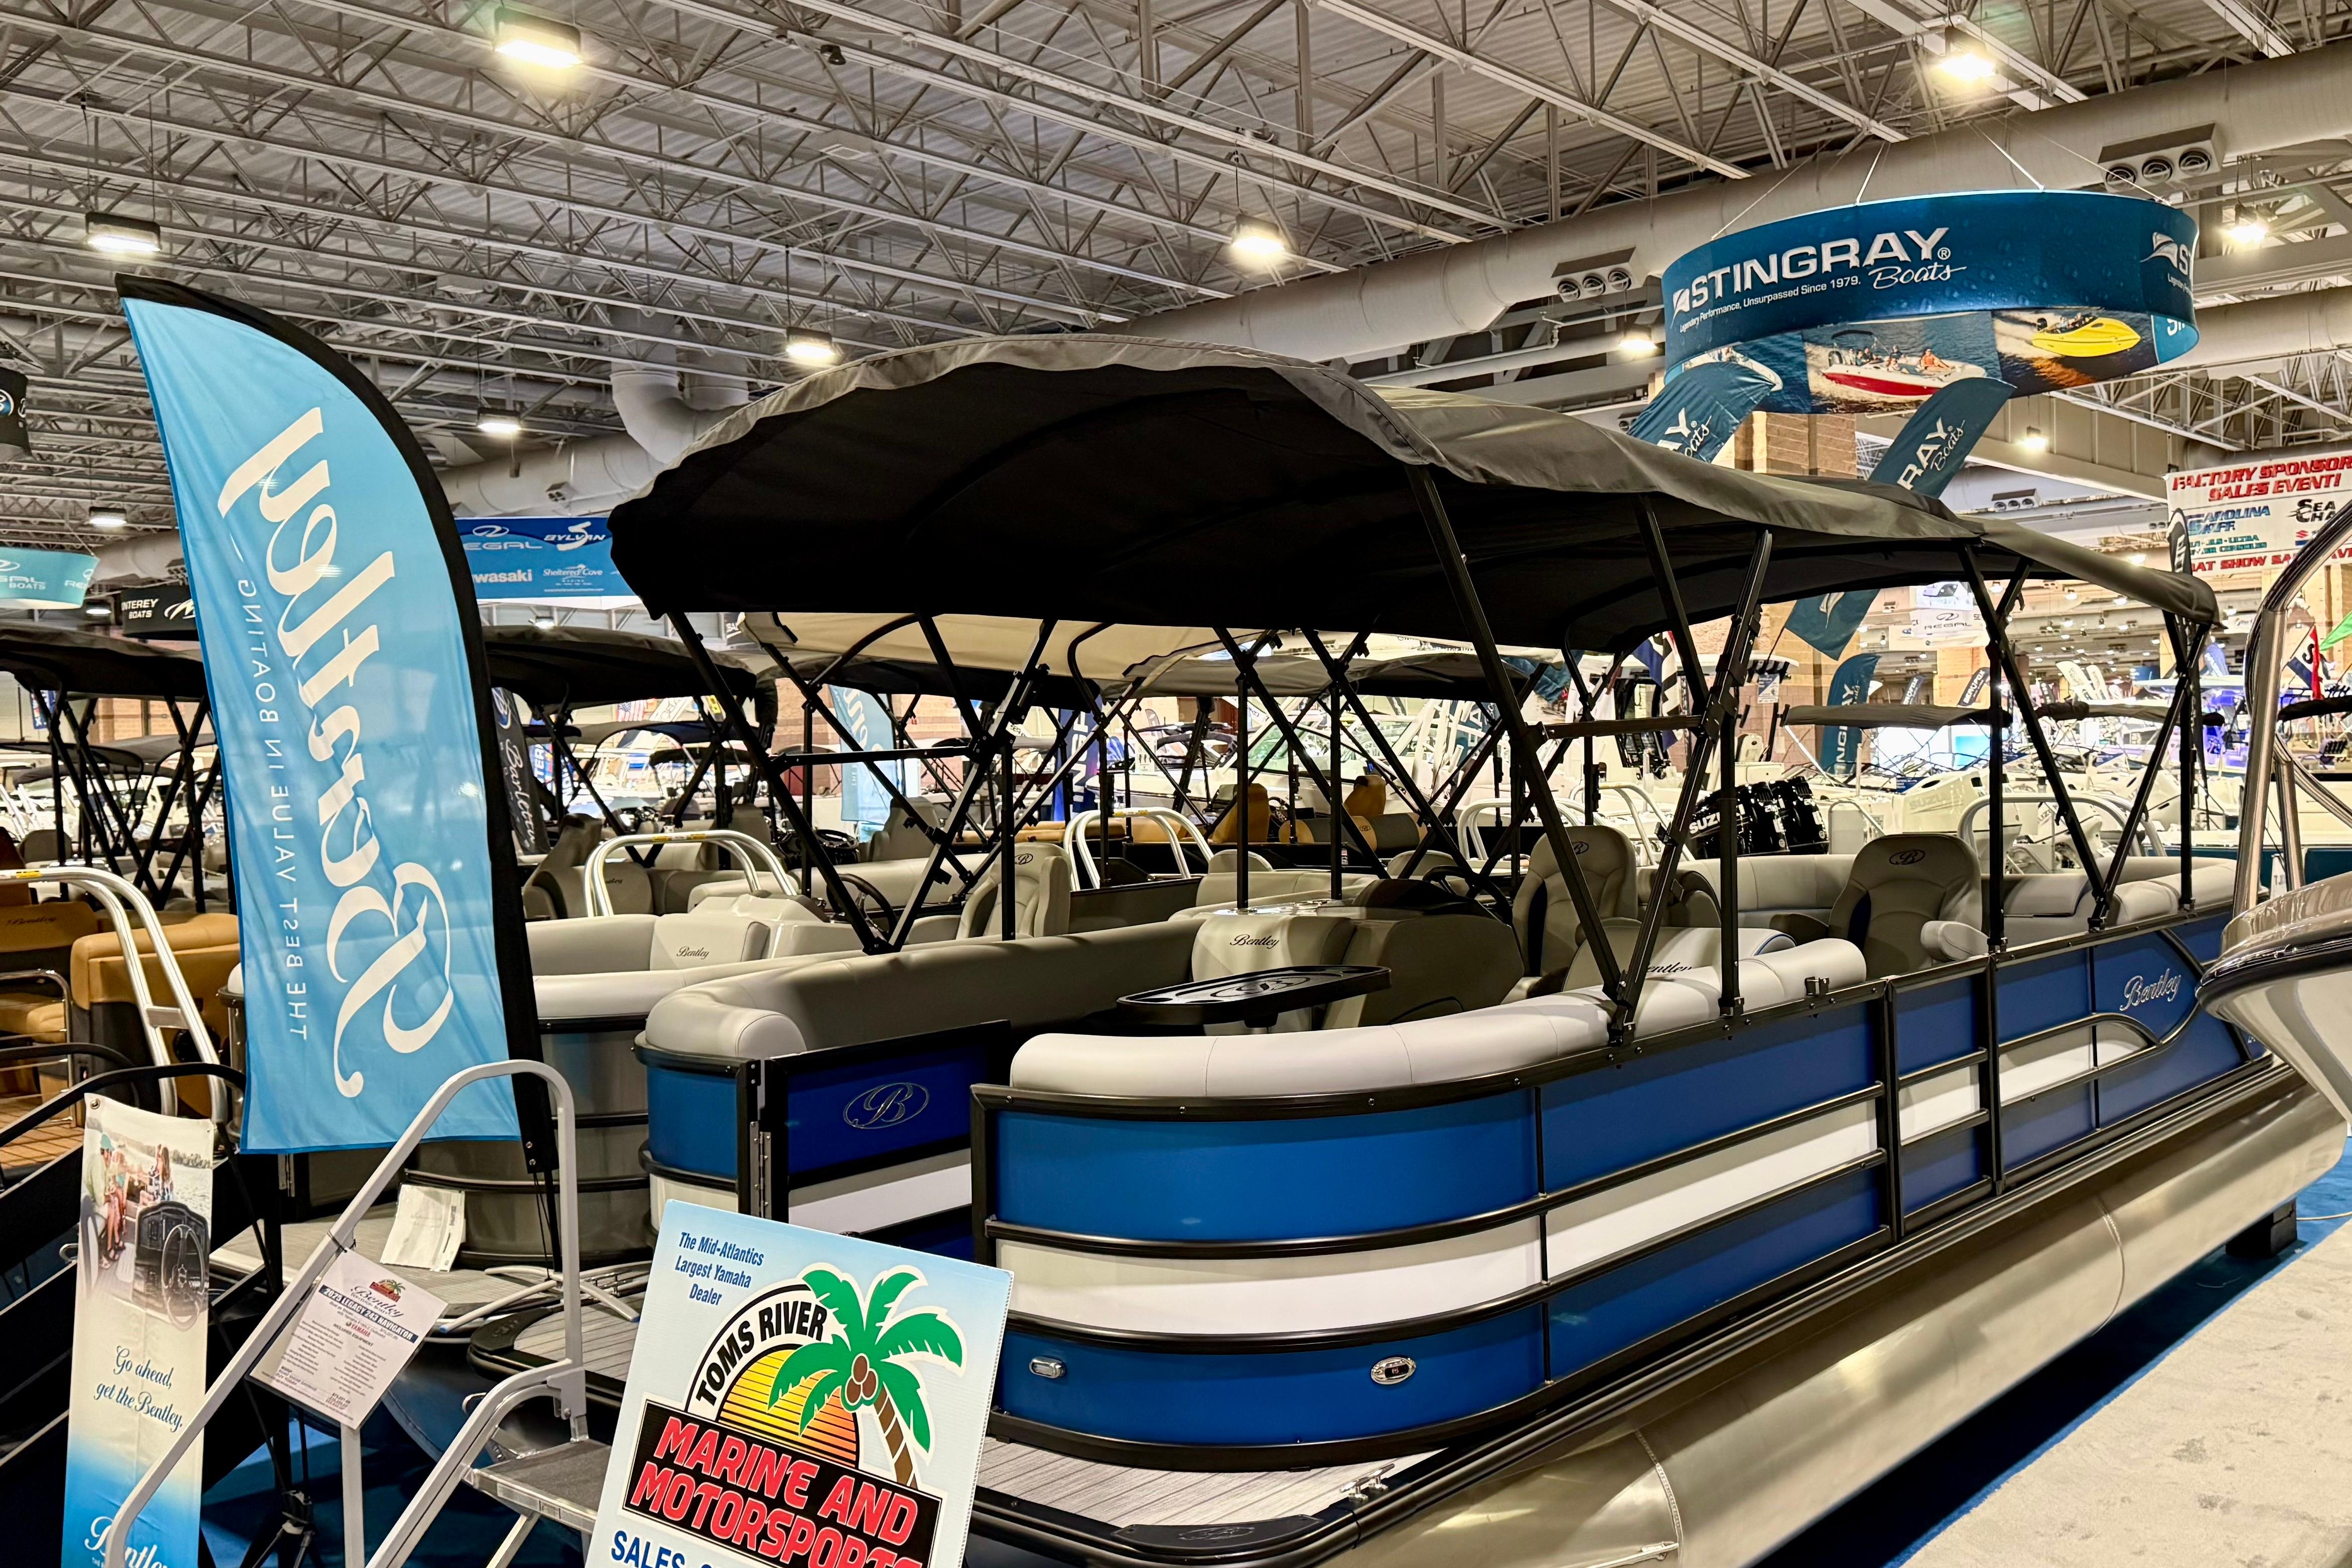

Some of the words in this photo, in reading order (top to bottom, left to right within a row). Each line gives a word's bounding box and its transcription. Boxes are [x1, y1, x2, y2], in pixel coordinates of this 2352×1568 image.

[1869, 264, 1967, 289] Boats
[1700, 303, 1742, 322] Performance,
[1743, 285, 1799, 308] Unsurpassed
[1801, 282, 1827, 294] Since
[1830, 275, 1861, 289] 1979.
[1685, 415, 1713, 456] oats
[2172, 467, 2258, 491] FACTORY
[2208, 480, 2270, 502] SALES
[2273, 473, 2342, 494] EVENT!
[2297, 499, 2336, 512] SEA
[463, 542, 543, 550] EGAL
[472, 569, 533, 583] wasaki
[2191, 561, 2216, 572] AT
[2220, 556, 2267, 569] SHOW
[121, 598, 159, 611] NTEREY
[129, 610, 152, 619] BOATS
[676, 946, 710, 960] Bentley
[1229, 934, 1280, 949] Bentley
[1647, 962, 1692, 973] entle
[2119, 968, 2182, 1011] Bentley
[679, 1232, 697, 1250] The
[698, 1236, 764, 1266] Mid-Atlantics
[675, 1255, 713, 1278] Largest
[714, 1264, 752, 1289] Yamaha
[350, 1285, 405, 1318] Bentley
[689, 1283, 722, 1306] Dealer
[323, 1287, 343, 1302] 2025
[340, 1297, 367, 1315] LEGACY
[363, 1309, 379, 1321] 243
[376, 1316, 414, 1340] NAVIGATOR
[349, 1323, 371, 1337] YAMAHA
[696, 1320, 754, 1406] TOMS
[758, 1301, 828, 1342] RIVER
[113, 1345, 133, 1375] Go
[135, 1359, 174, 1390] ahead,
[93, 1384, 116, 1400] get
[116, 1386, 135, 1408] the
[135, 1391, 182, 1433] Bentley.
[653, 1416, 821, 1509] MARINE
[817, 1475, 919, 1547] AND
[630, 1461, 924, 1568] MOTORSPOR
